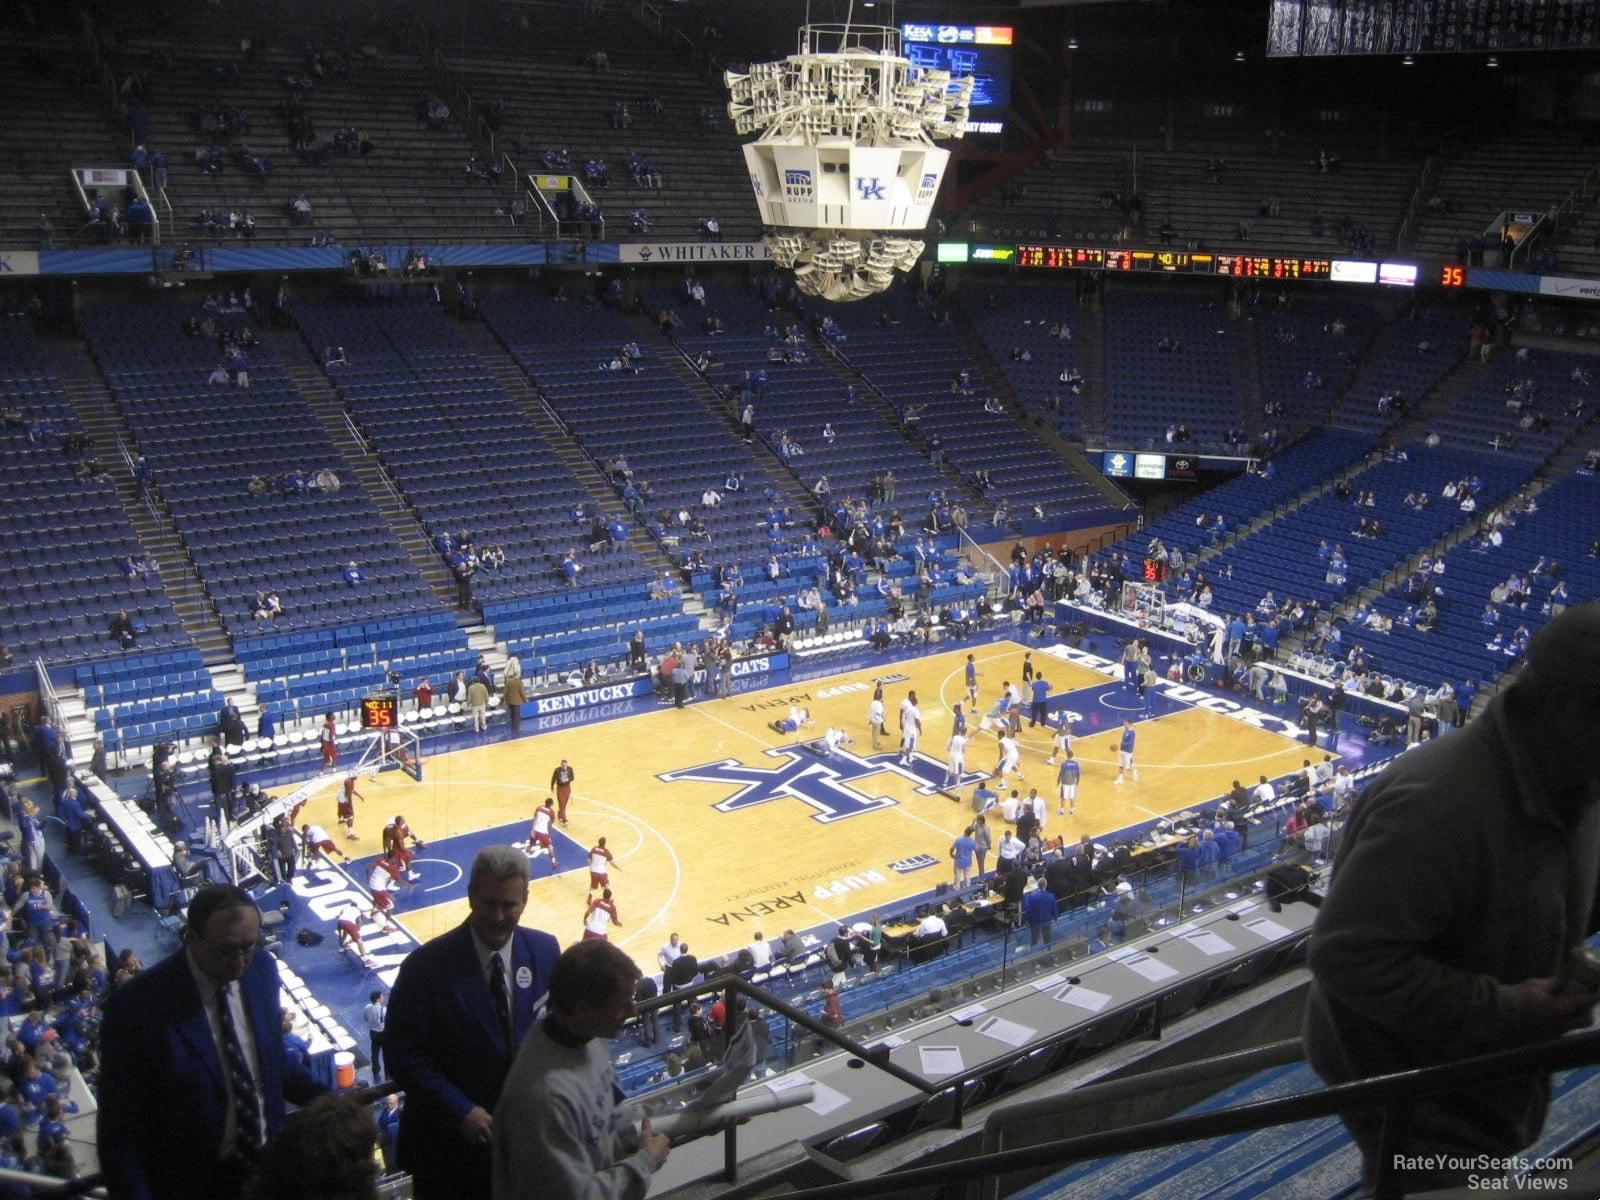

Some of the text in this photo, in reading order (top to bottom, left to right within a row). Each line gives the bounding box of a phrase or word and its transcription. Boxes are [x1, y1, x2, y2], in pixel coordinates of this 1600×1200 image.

[786, 186, 813, 196] RUPP
[856, 177, 886, 201] UK
[787, 196, 814, 204] ARENA
[658, 245, 756, 260] WHITAKER
[1442, 267, 1461, 285] 35
[1145, 567, 1156, 580] 35
[537, 682, 635, 714] KENTUCKY
[369, 709, 391, 726] 35
[811, 868, 889, 900] RUPP
[706, 890, 808, 926] ARENA
